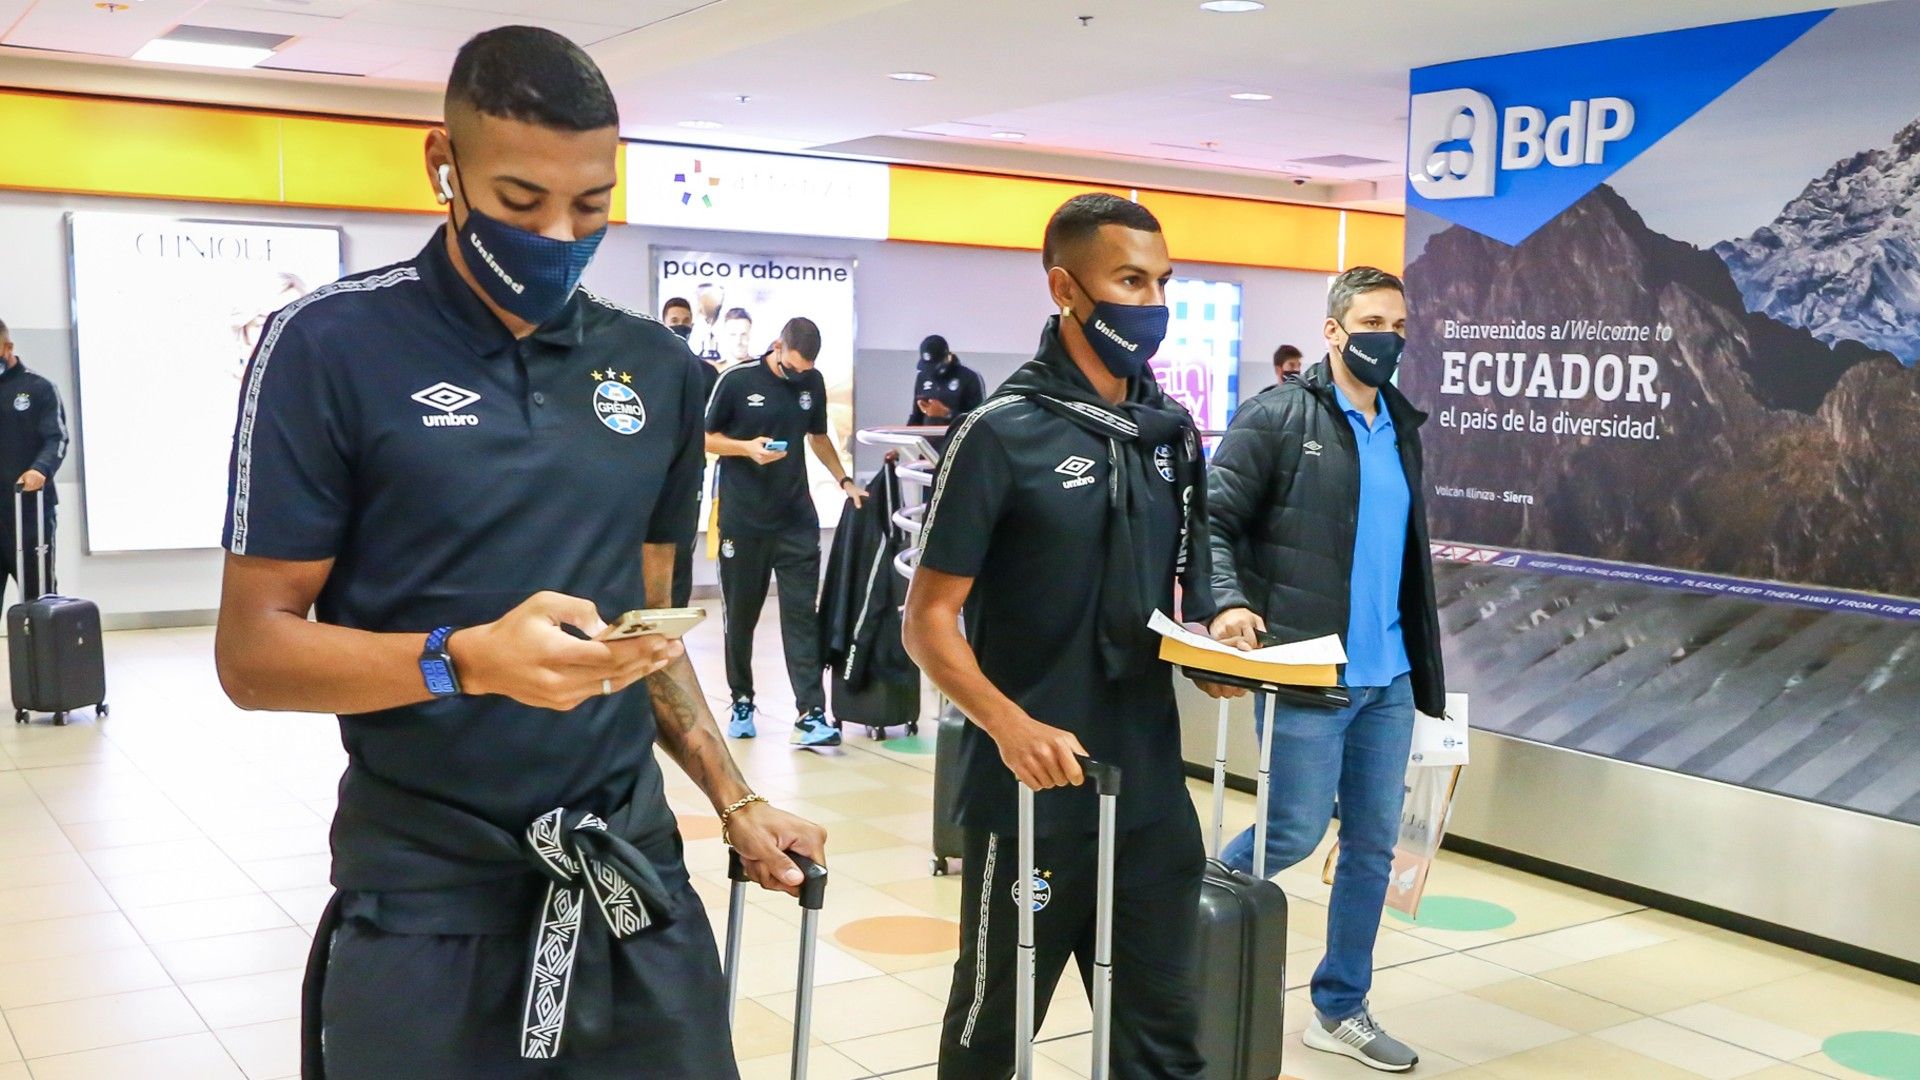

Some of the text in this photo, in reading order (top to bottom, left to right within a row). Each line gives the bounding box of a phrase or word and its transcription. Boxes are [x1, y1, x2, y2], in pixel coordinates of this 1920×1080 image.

[1501, 97, 1635, 170] BdP
[470, 232, 526, 295] Unimed
[663, 259, 848, 282] paco rabanne
[1094, 319, 1139, 353] Unimed
[1443, 320, 1547, 340] Bienvenidos
[1655, 322, 1673, 342] to
[1349, 344, 1378, 366] Unimed
[1440, 351, 1672, 410] ECUADOR,
[422, 413, 479, 427] umbro
[1439, 406, 1661, 440] el país de la diversidad.
[1062, 475, 1096, 489] umbro
[1503, 491, 1534, 505] Sierra
[1642, 573, 1675, 584] SAFE
[1680, 578, 1729, 591] PLEASE
[1727, 585, 1763, 594] KEEP
[1763, 589, 1800, 600] THEM
[1799, 594, 1838, 605] AWAY
[1836, 599, 1879, 610] FROM
[1880, 604, 1910, 614] THE
